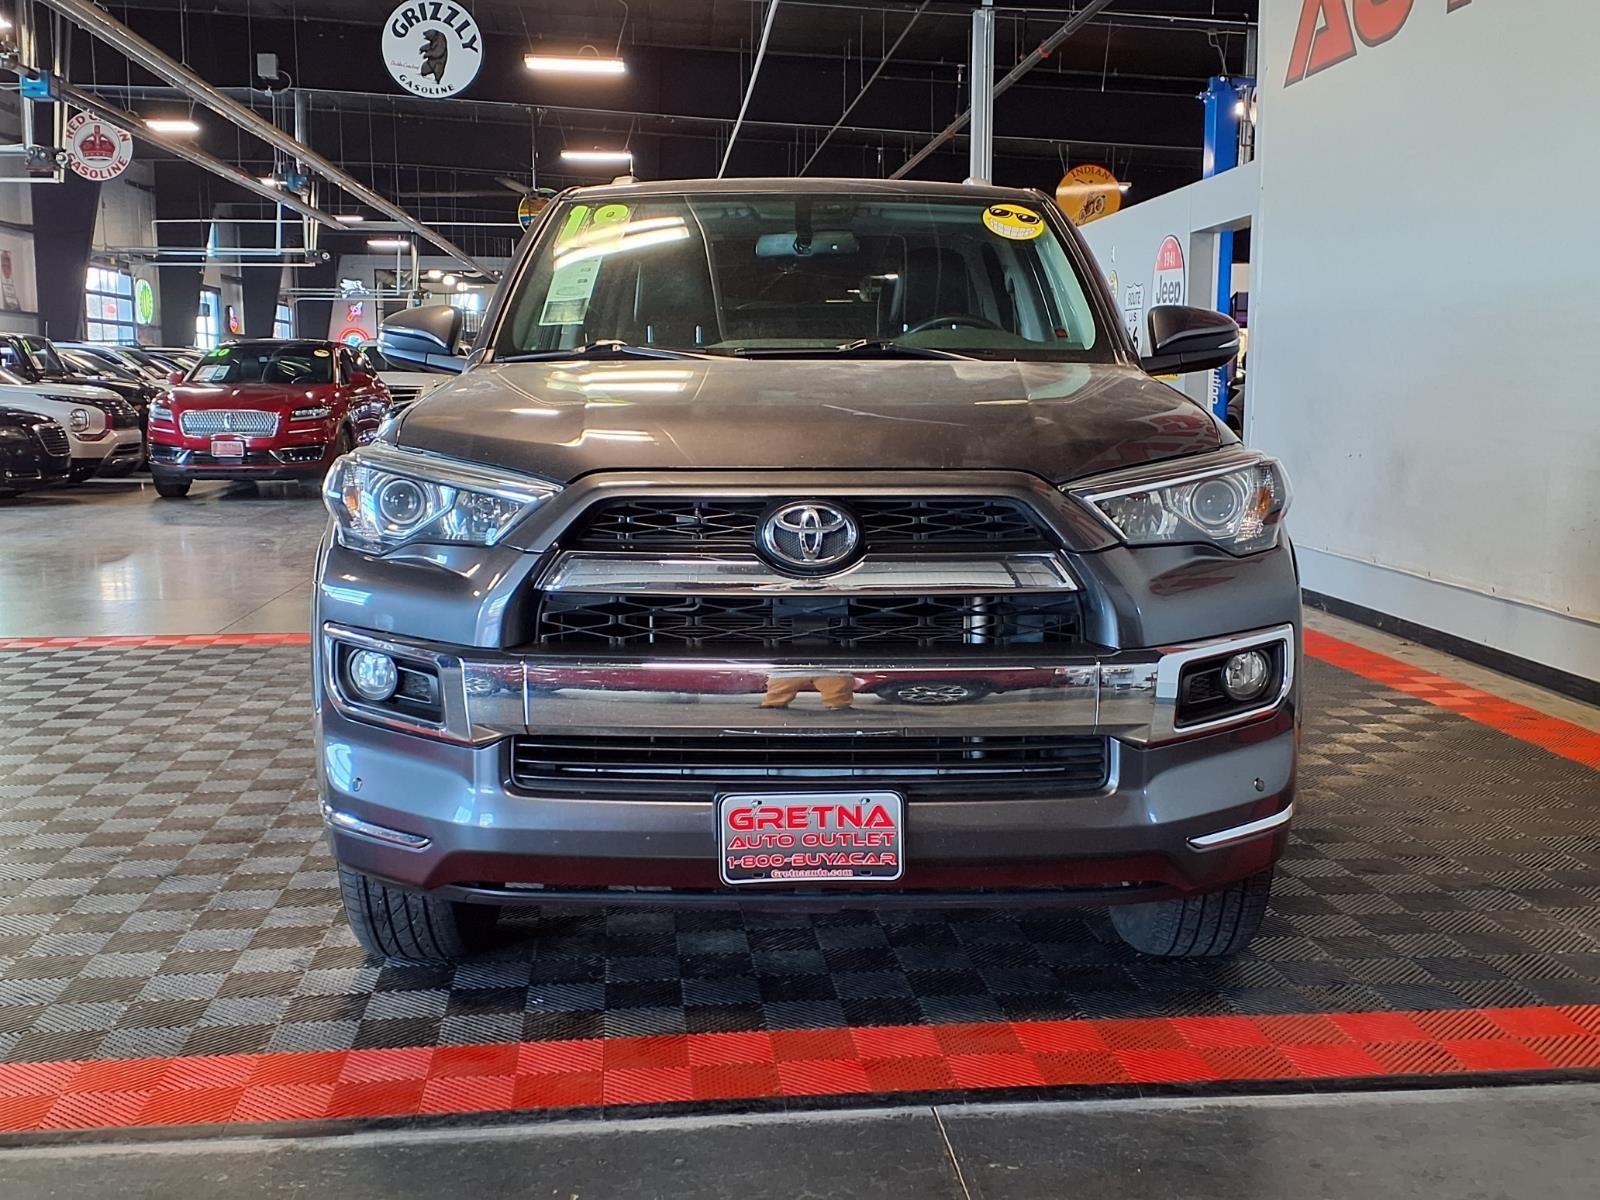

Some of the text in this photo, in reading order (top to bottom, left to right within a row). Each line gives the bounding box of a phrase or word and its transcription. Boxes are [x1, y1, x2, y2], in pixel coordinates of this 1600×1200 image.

[391, 1, 479, 54] GRIZZLY
[399, 74, 455, 95] GASOLINE
[66, 115, 86, 140] RED
[66, 152, 128, 179] GASOLINE
[1071, 166, 1111, 180] INDIAN
[1128, 291, 1141, 306] ROUTE
[1155, 275, 1181, 307] Jeep
[1129, 312, 1137, 322] US
[727, 805, 896, 831] GRETNA
[727, 832, 896, 850] AUTO OUTLET
[727, 852, 897, 869] 1-800-BUYACAR
[770, 869, 854, 879] Gretnaauto.com
